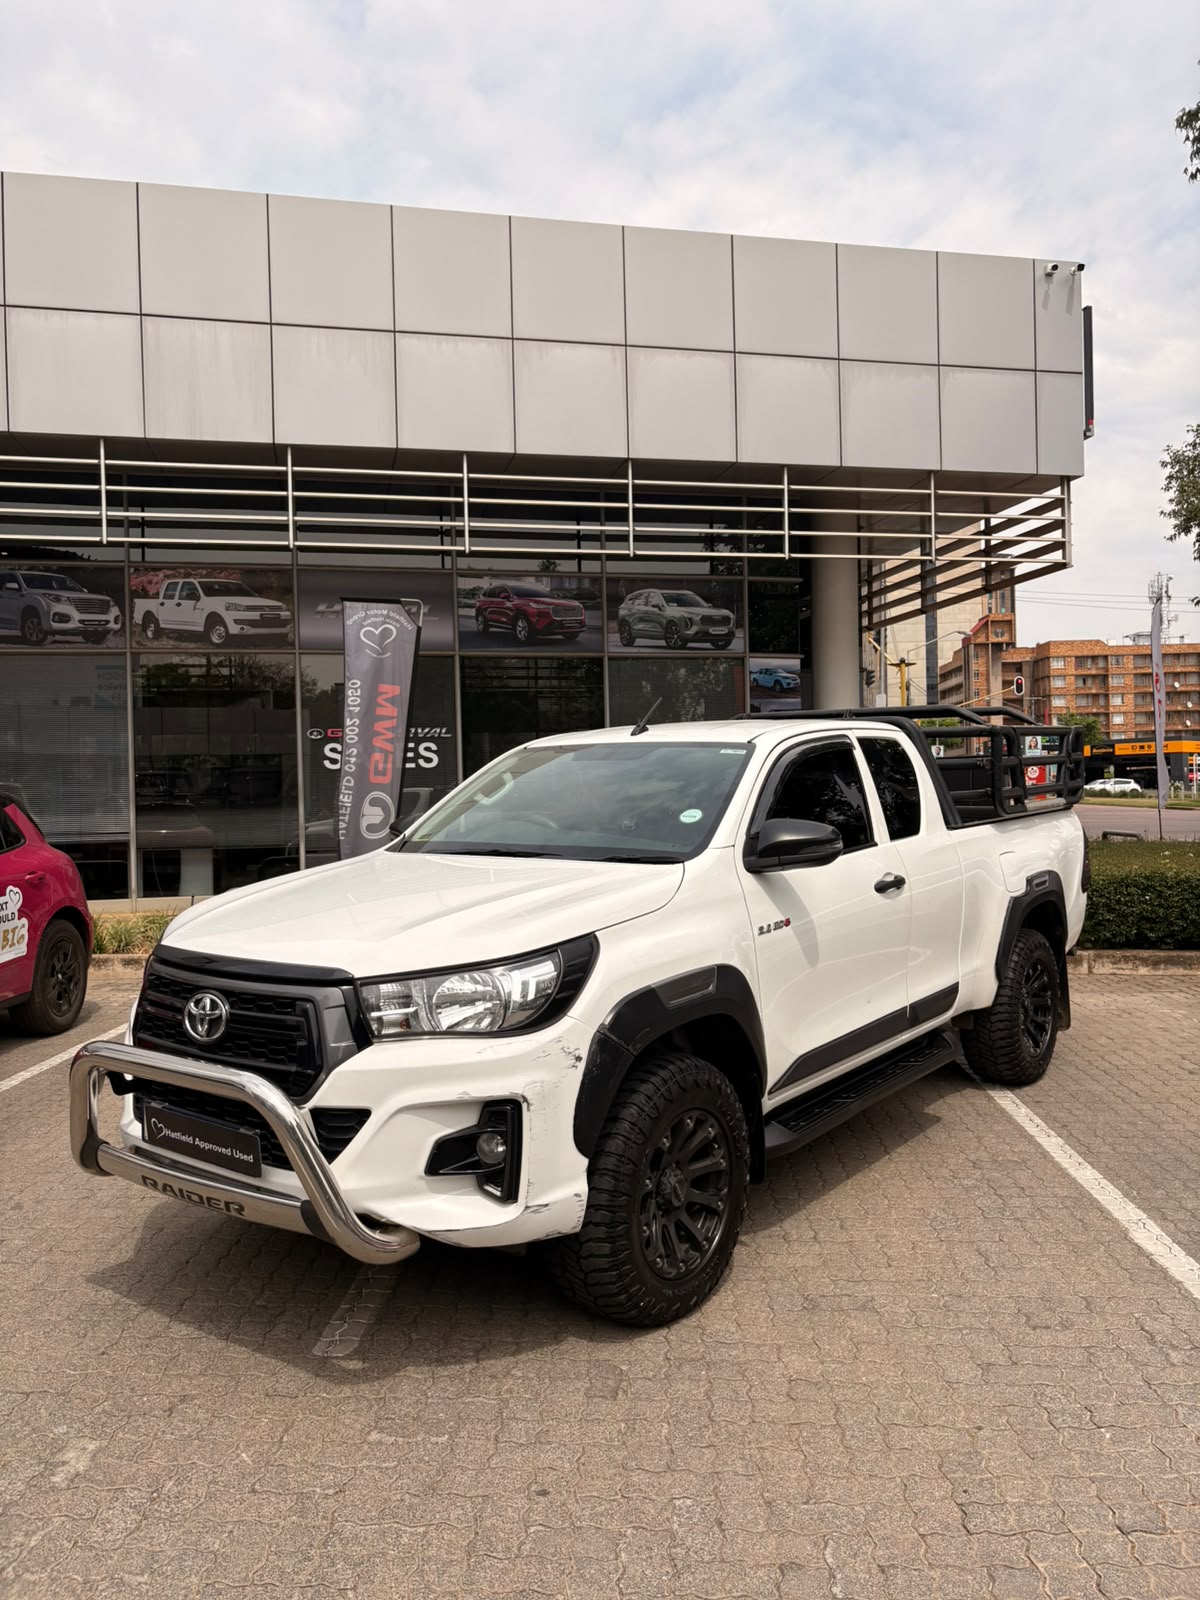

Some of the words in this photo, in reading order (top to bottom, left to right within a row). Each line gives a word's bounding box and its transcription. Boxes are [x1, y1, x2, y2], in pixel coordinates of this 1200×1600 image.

[409, 727, 452, 737] VAL
[165, 1128, 194, 1145] Hatfield
[194, 1137, 232, 1156] Approved
[232, 1148, 254, 1163] Used
[141, 1174, 246, 1216] RAIDER
